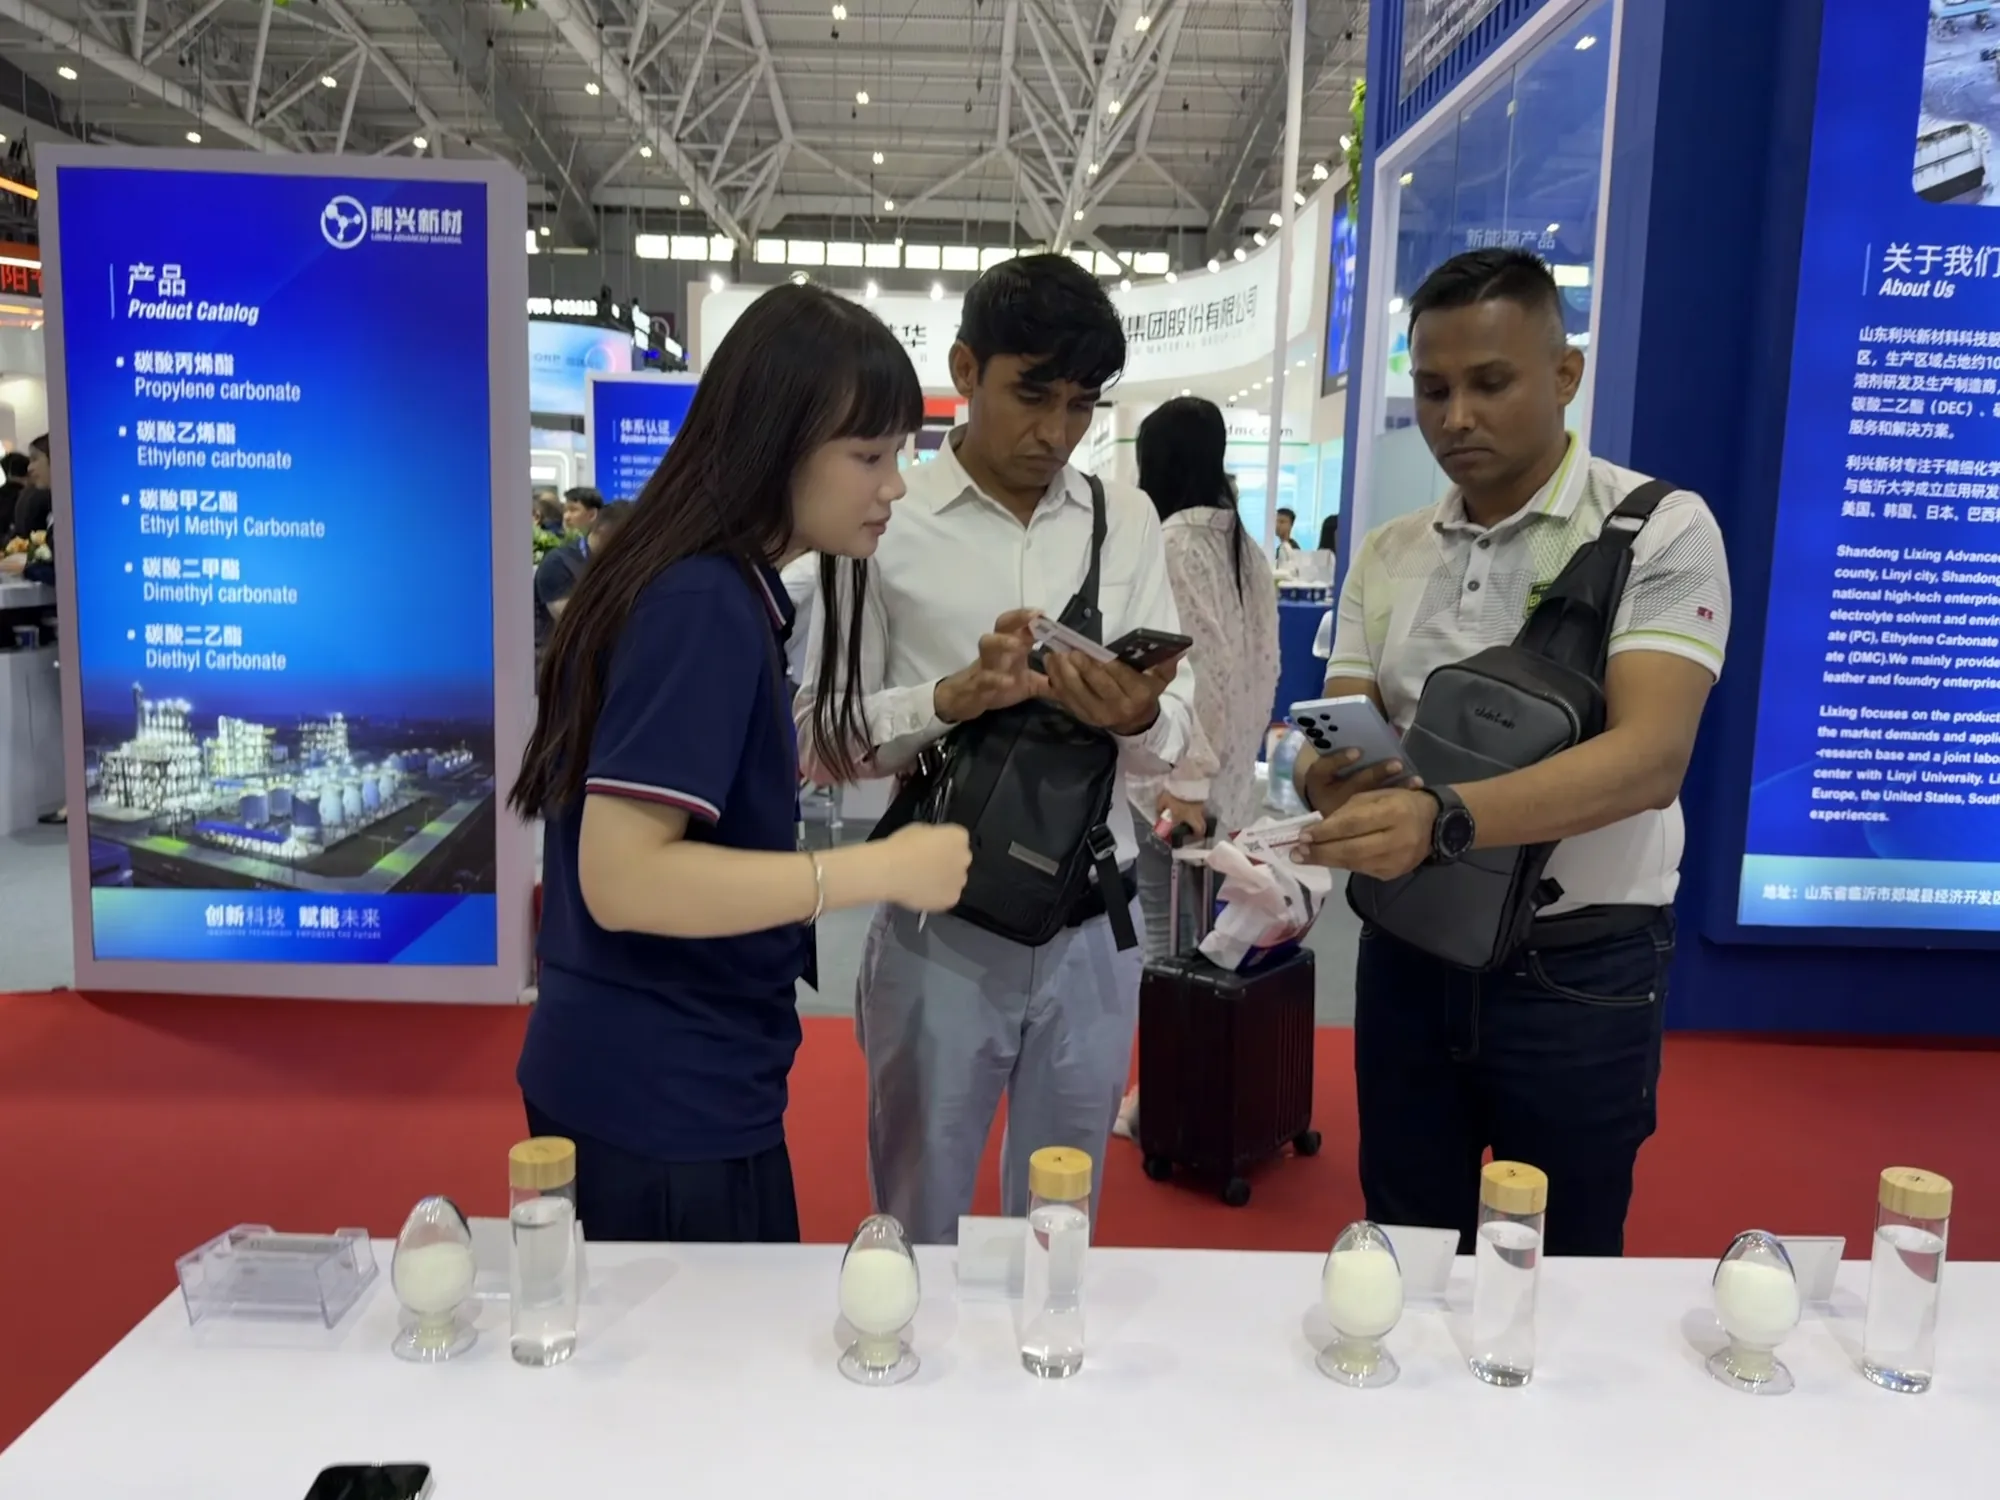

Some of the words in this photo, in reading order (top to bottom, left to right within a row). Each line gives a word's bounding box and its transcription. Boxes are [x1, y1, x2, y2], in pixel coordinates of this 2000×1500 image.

[371, 206, 463, 235] 利兴新材
[1466, 229, 1556, 250] 新能源产品
[1882, 242, 2000, 278] 关于我们
[128, 261, 186, 297] 产品
[1878, 277, 1931, 297] About
[1933, 279, 1956, 298] Us
[128, 298, 193, 320] Product
[196, 301, 260, 327] Catalog
[1126, 285, 1258, 342] 集团股份有限公司
[134, 351, 235, 376] 碳酸丙烯酯
[134, 377, 215, 402] Propylene
[220, 380, 301, 402] carbonate
[137, 420, 236, 445] 碳酸乙烯酯
[137, 446, 206, 470] Ethylene
[211, 449, 292, 470] carbonate
[139, 488, 238, 513] 碳酸甲乙酯
[140, 514, 180, 538] Ethyl
[185, 515, 239, 540] Methyl
[243, 516, 326, 538] Carbonate
[1836, 544, 1899, 562] Shandong
[1903, 547, 1941, 563] Lixing
[142, 556, 241, 581] 碳酸二甲酯
[1834, 567, 1879, 582] county,
[1882, 568, 1912, 583] Linyi
[1914, 569, 1939, 584] city,
[1942, 570, 2000, 587] Shandong
[143, 582, 213, 606] Dimethyl
[218, 584, 298, 605] carbonate
[1832, 588, 1882, 601] national
[1884, 589, 1941, 604] high-tech
[1829, 608, 1894, 624] electrolyte
[1896, 611, 1941, 625] solvent
[1943, 613, 1967, 625] and
[145, 623, 243, 647] 碳酸二乙酯
[1827, 630, 1847, 642] ate
[1849, 630, 1879, 645] (PC),
[1881, 631, 1934, 646] Ethylene
[1936, 633, 1999, 648] Carbonate
[146, 648, 200, 672] Diethyl
[205, 649, 288, 671] Carbonate
[1825, 651, 1845, 663] ate
[1911, 654, 1952, 669] mainly
[1955, 655, 2000, 669] provide
[1823, 671, 1866, 683] leather
[1867, 673, 1891, 685] and
[1893, 674, 1940, 689] foundry
[1819, 704, 1858, 720] Lixing
[1861, 706, 1908, 720] focuses
[1911, 710, 1927, 721] on
[1931, 709, 1950, 722] the
[1817, 726, 1838, 738] the
[1840, 726, 1882, 739] market
[1885, 729, 1940, 742] demands
[1943, 730, 1966, 743] and
[1969, 731, 2000, 745] appli
[1875, 749, 1904, 761] base
[1907, 750, 1930, 762] and
[1933, 753, 1941, 762] a
[1942, 750, 1971, 766] joint
[1974, 752, 2000, 764] labo
[1813, 768, 1852, 780] center
[1856, 768, 1882, 781] with
[1886, 769, 1917, 784] Linyi
[1921, 771, 1984, 787] University.
[1811, 787, 1858, 802] Europe,
[1861, 788, 1881, 800] the
[1883, 790, 1921, 803] United
[1924, 791, 1965, 805] States,
[1809, 808, 1890, 822] experiences.
[205, 904, 285, 929] 创新科技
[299, 905, 381, 930] 赋能未来
